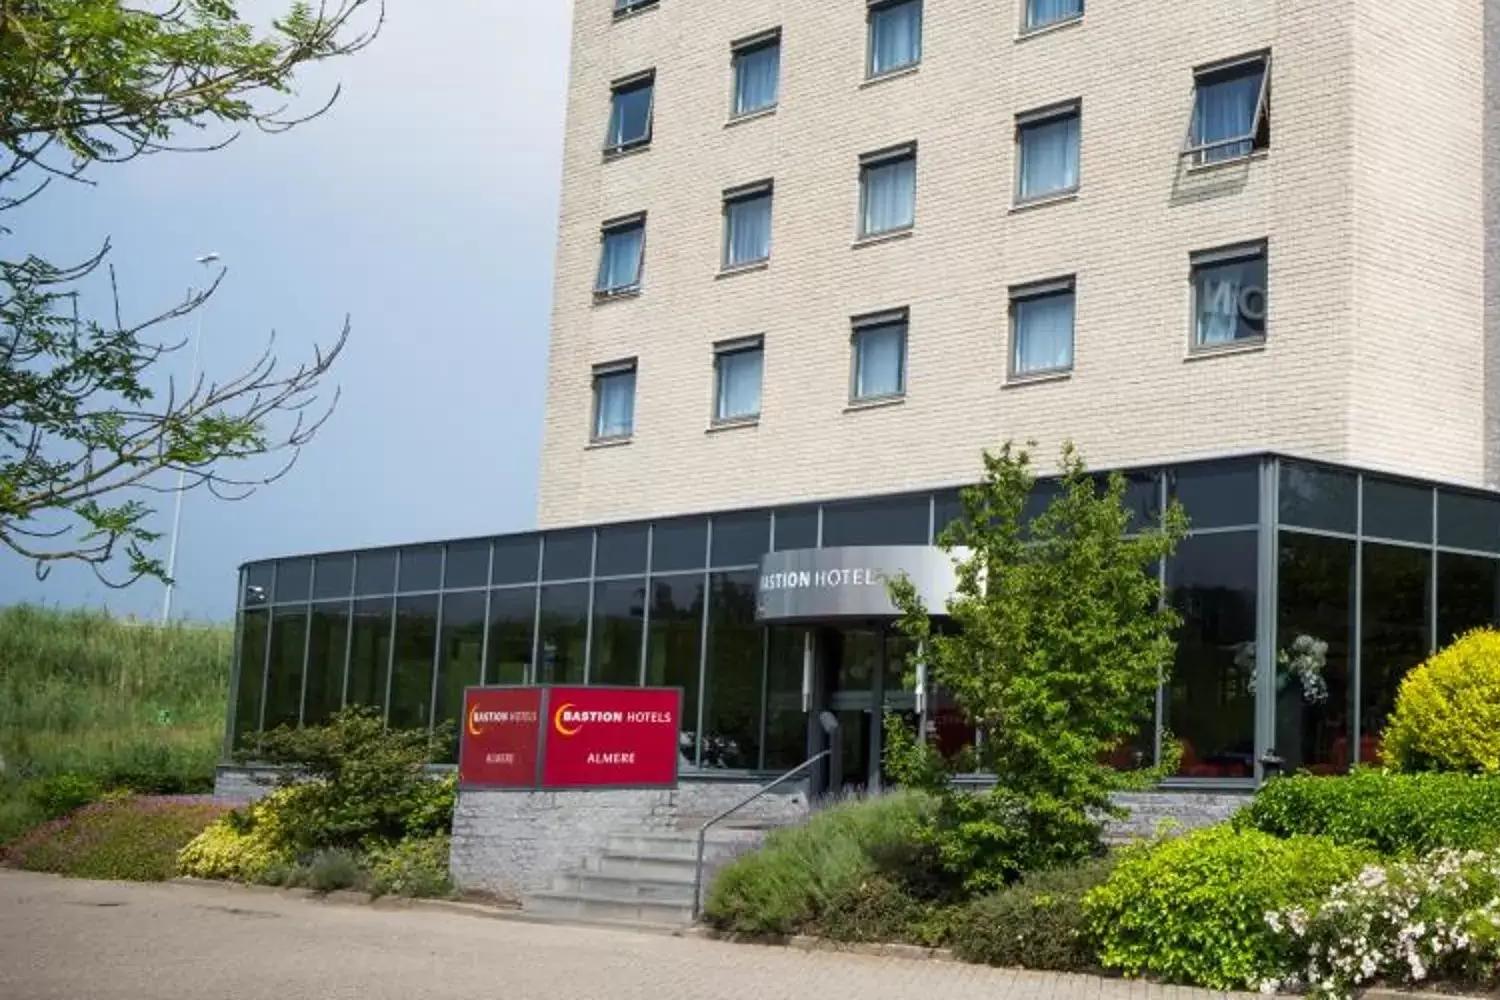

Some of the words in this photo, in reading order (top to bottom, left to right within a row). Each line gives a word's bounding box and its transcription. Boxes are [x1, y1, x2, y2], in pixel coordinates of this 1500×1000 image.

[563, 711, 623, 722] BASTION
[626, 711, 672, 723] HOTELS
[587, 752, 635, 764] ALMERE
